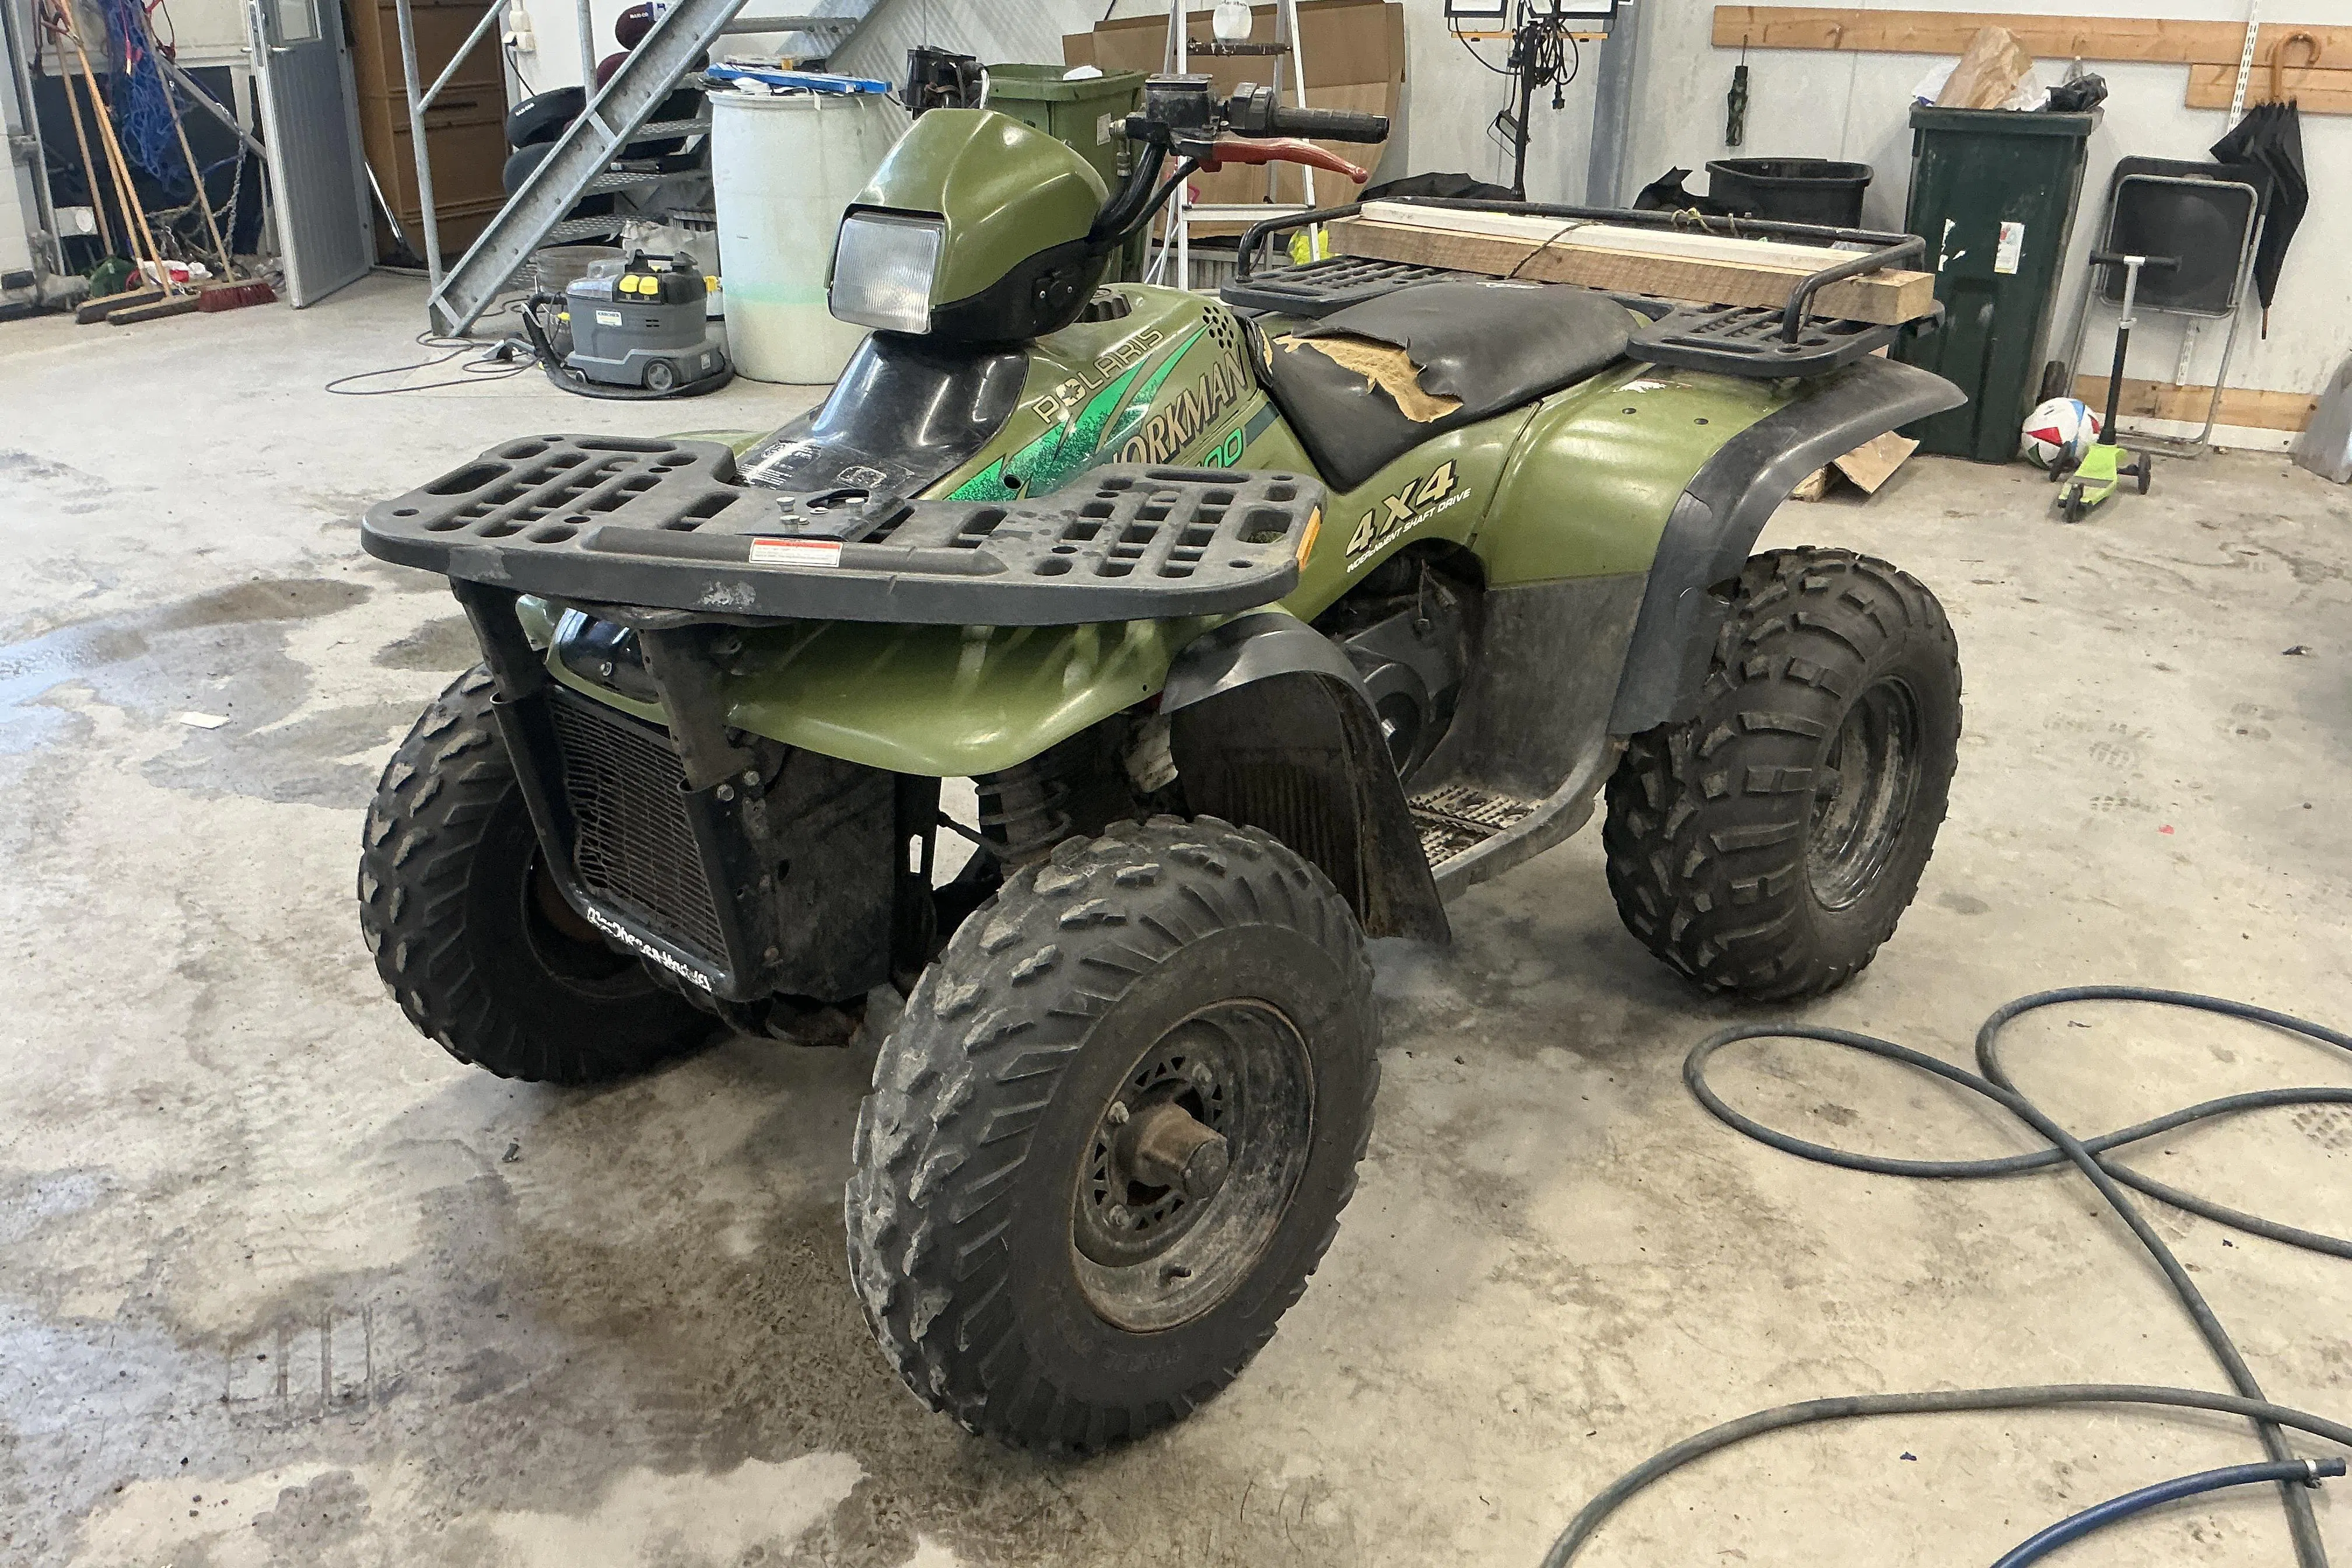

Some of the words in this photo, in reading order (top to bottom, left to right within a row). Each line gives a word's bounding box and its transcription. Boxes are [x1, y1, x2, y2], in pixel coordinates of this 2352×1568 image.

[1031, 330, 1164, 425] POLARIS
[1112, 347, 1249, 465] ORKMAN
[1345, 458, 1458, 558] 4X4
[1402, 506, 1436, 533] SHAFT
[1437, 487, 1472, 513] DRIVE
